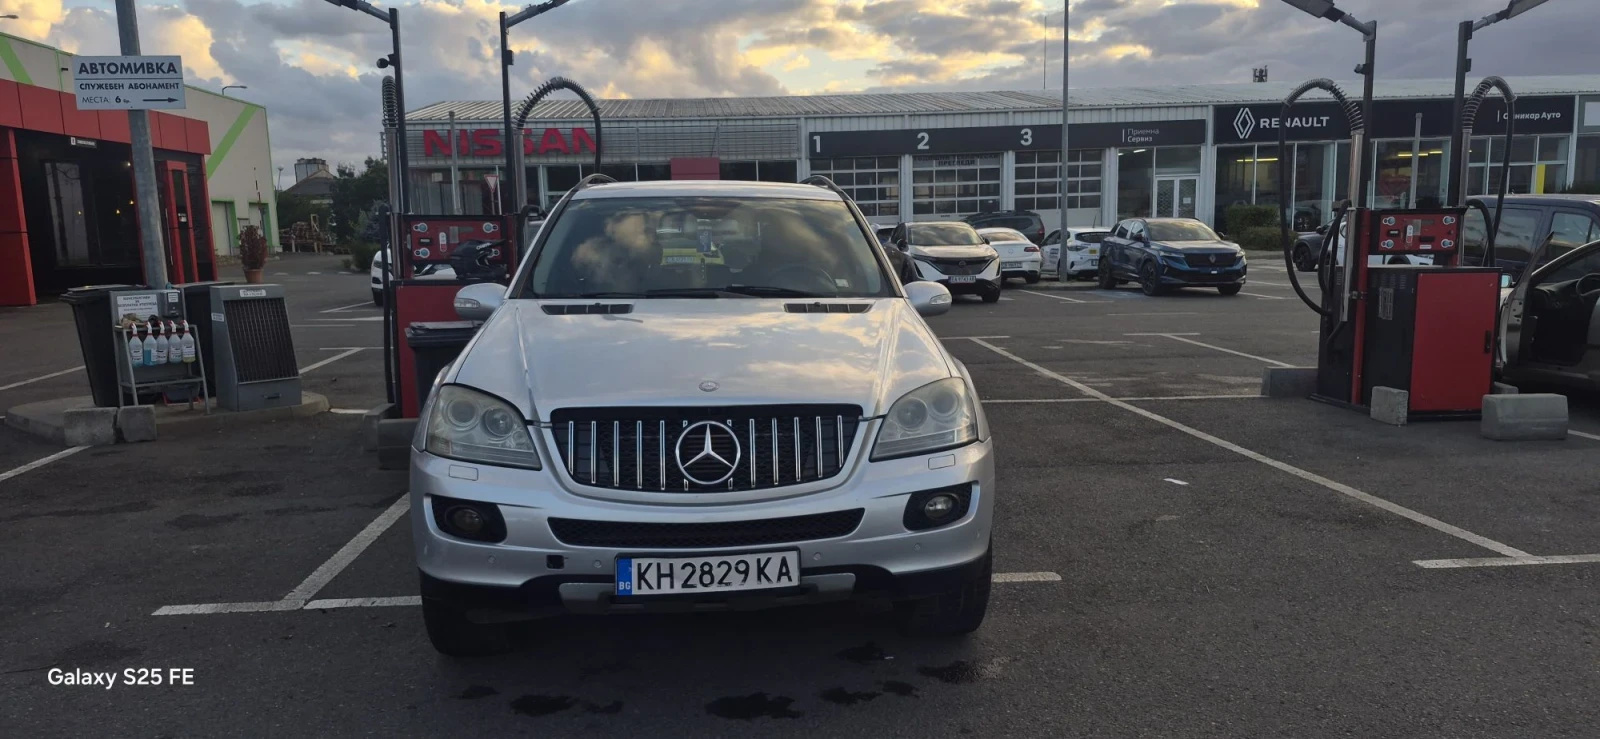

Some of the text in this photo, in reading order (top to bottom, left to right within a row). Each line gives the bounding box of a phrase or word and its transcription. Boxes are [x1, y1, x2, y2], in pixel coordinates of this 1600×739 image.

[79, 62, 178, 75] АВТОМИВКА
[80, 82, 180, 90] СЛУЖЕБЕН АБОНАМЕНТ
[82, 96, 111, 104] МЕСТА:
[115, 95, 121, 104] 6
[1541, 111, 1561, 121] Ауто
[917, 132, 930, 150] 2
[1020, 128, 1033, 146] 3
[813, 135, 821, 153] 1
[618, 581, 631, 590] BG
